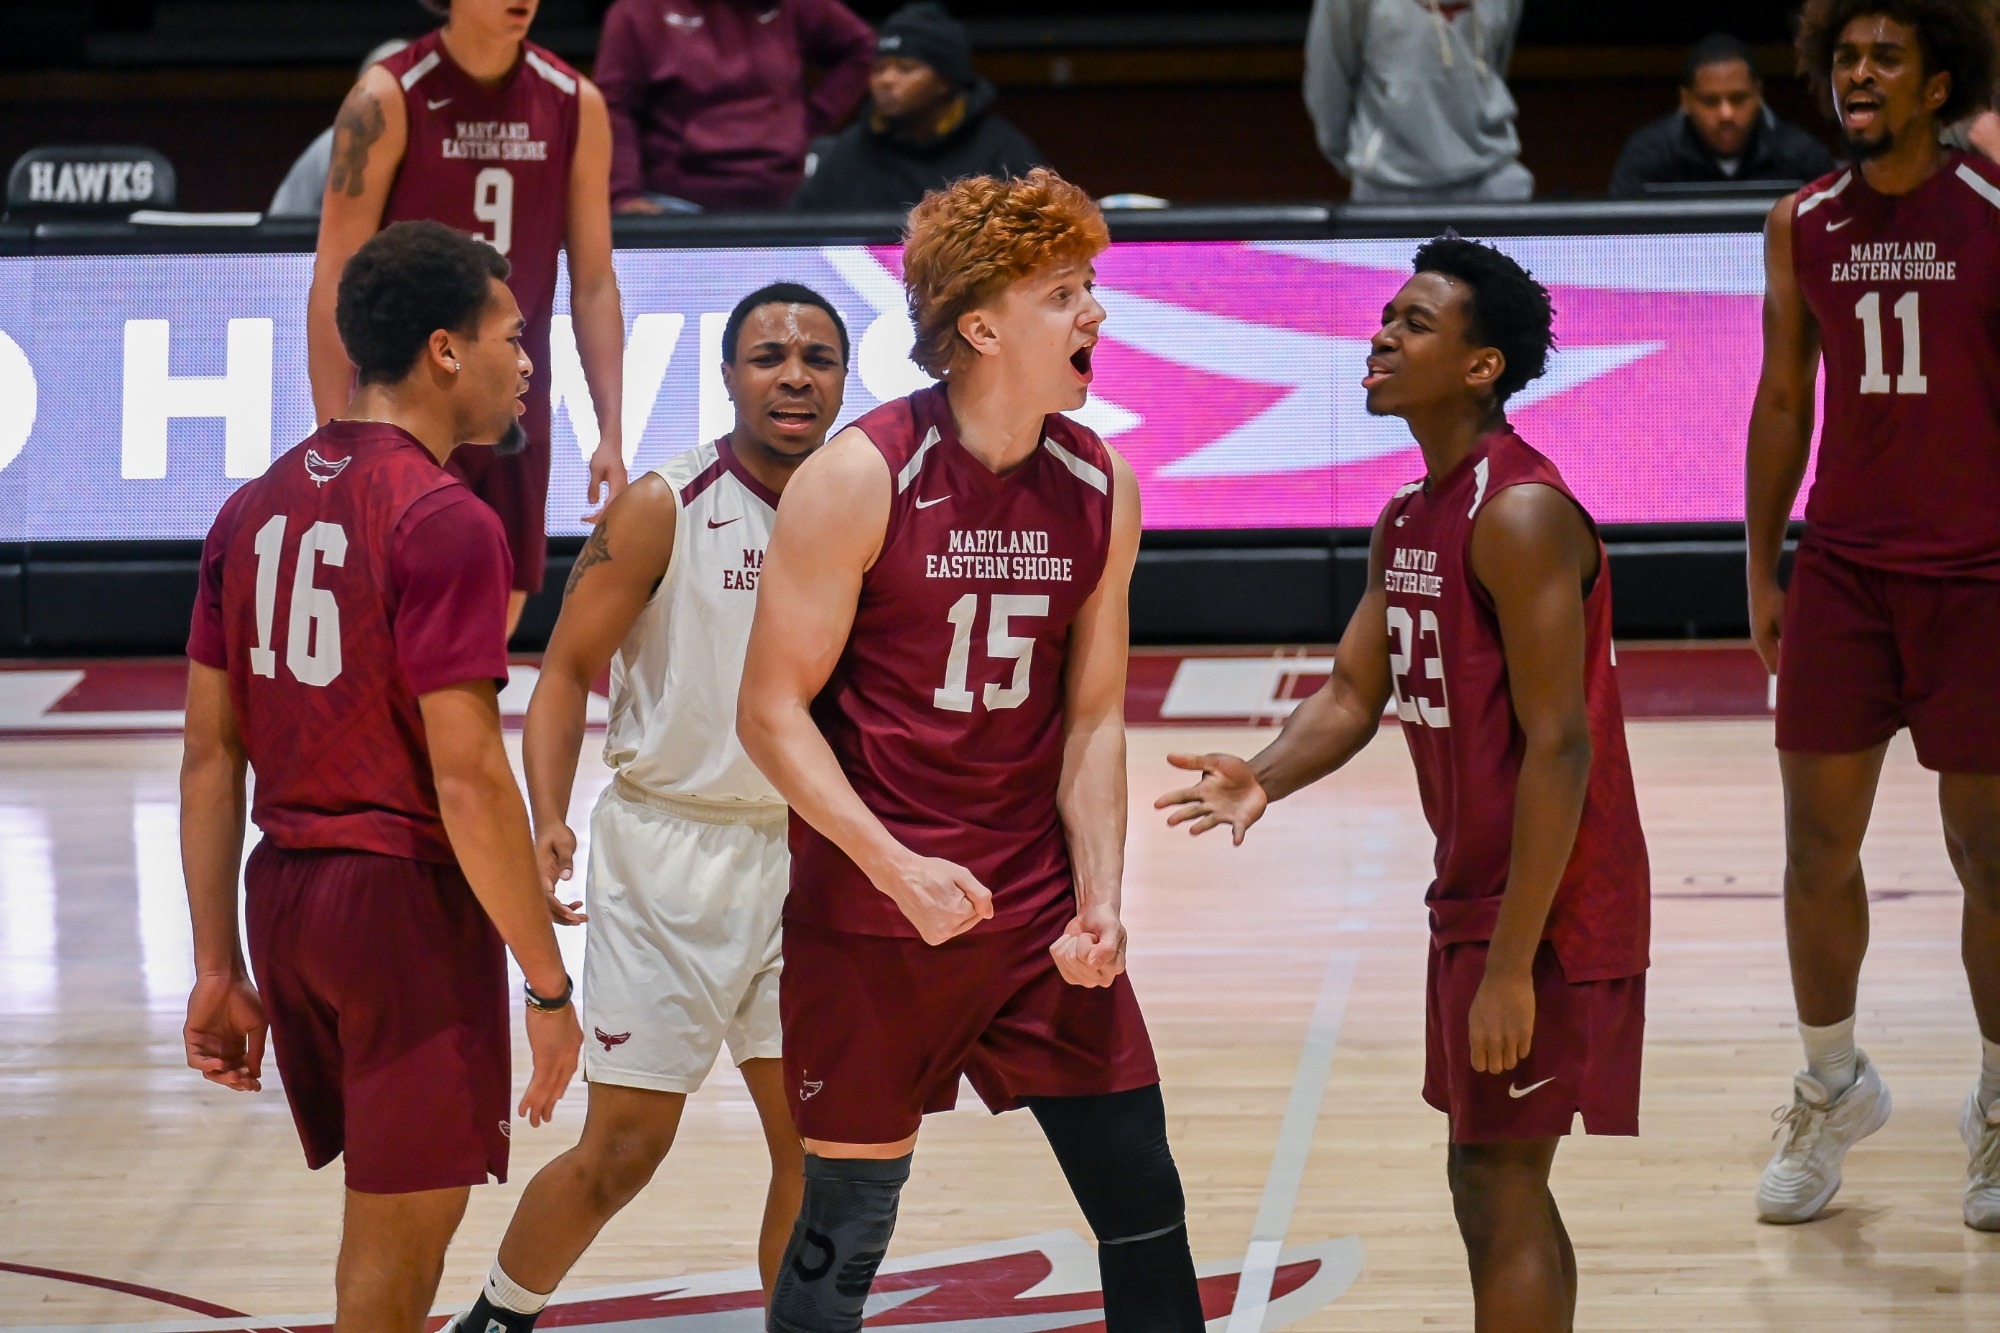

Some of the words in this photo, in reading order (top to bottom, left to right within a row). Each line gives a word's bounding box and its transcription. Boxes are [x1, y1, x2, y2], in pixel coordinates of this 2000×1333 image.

[29, 160, 154, 203] HAWKS
[472, 168, 514, 257] 9
[1831, 262, 1900, 281] EASTERN
[1904, 261, 1956, 280] SHORE
[1850, 242, 1936, 261] MARYLAND
[1855, 291, 1927, 394] 11
[926, 555, 1009, 579] EASTERN
[1013, 557, 1072, 581] SHORE
[948, 530, 1048, 554] MARYLAND
[250, 514, 348, 687] 16
[933, 594, 1049, 713] 15
[1386, 606, 1451, 728] 23
